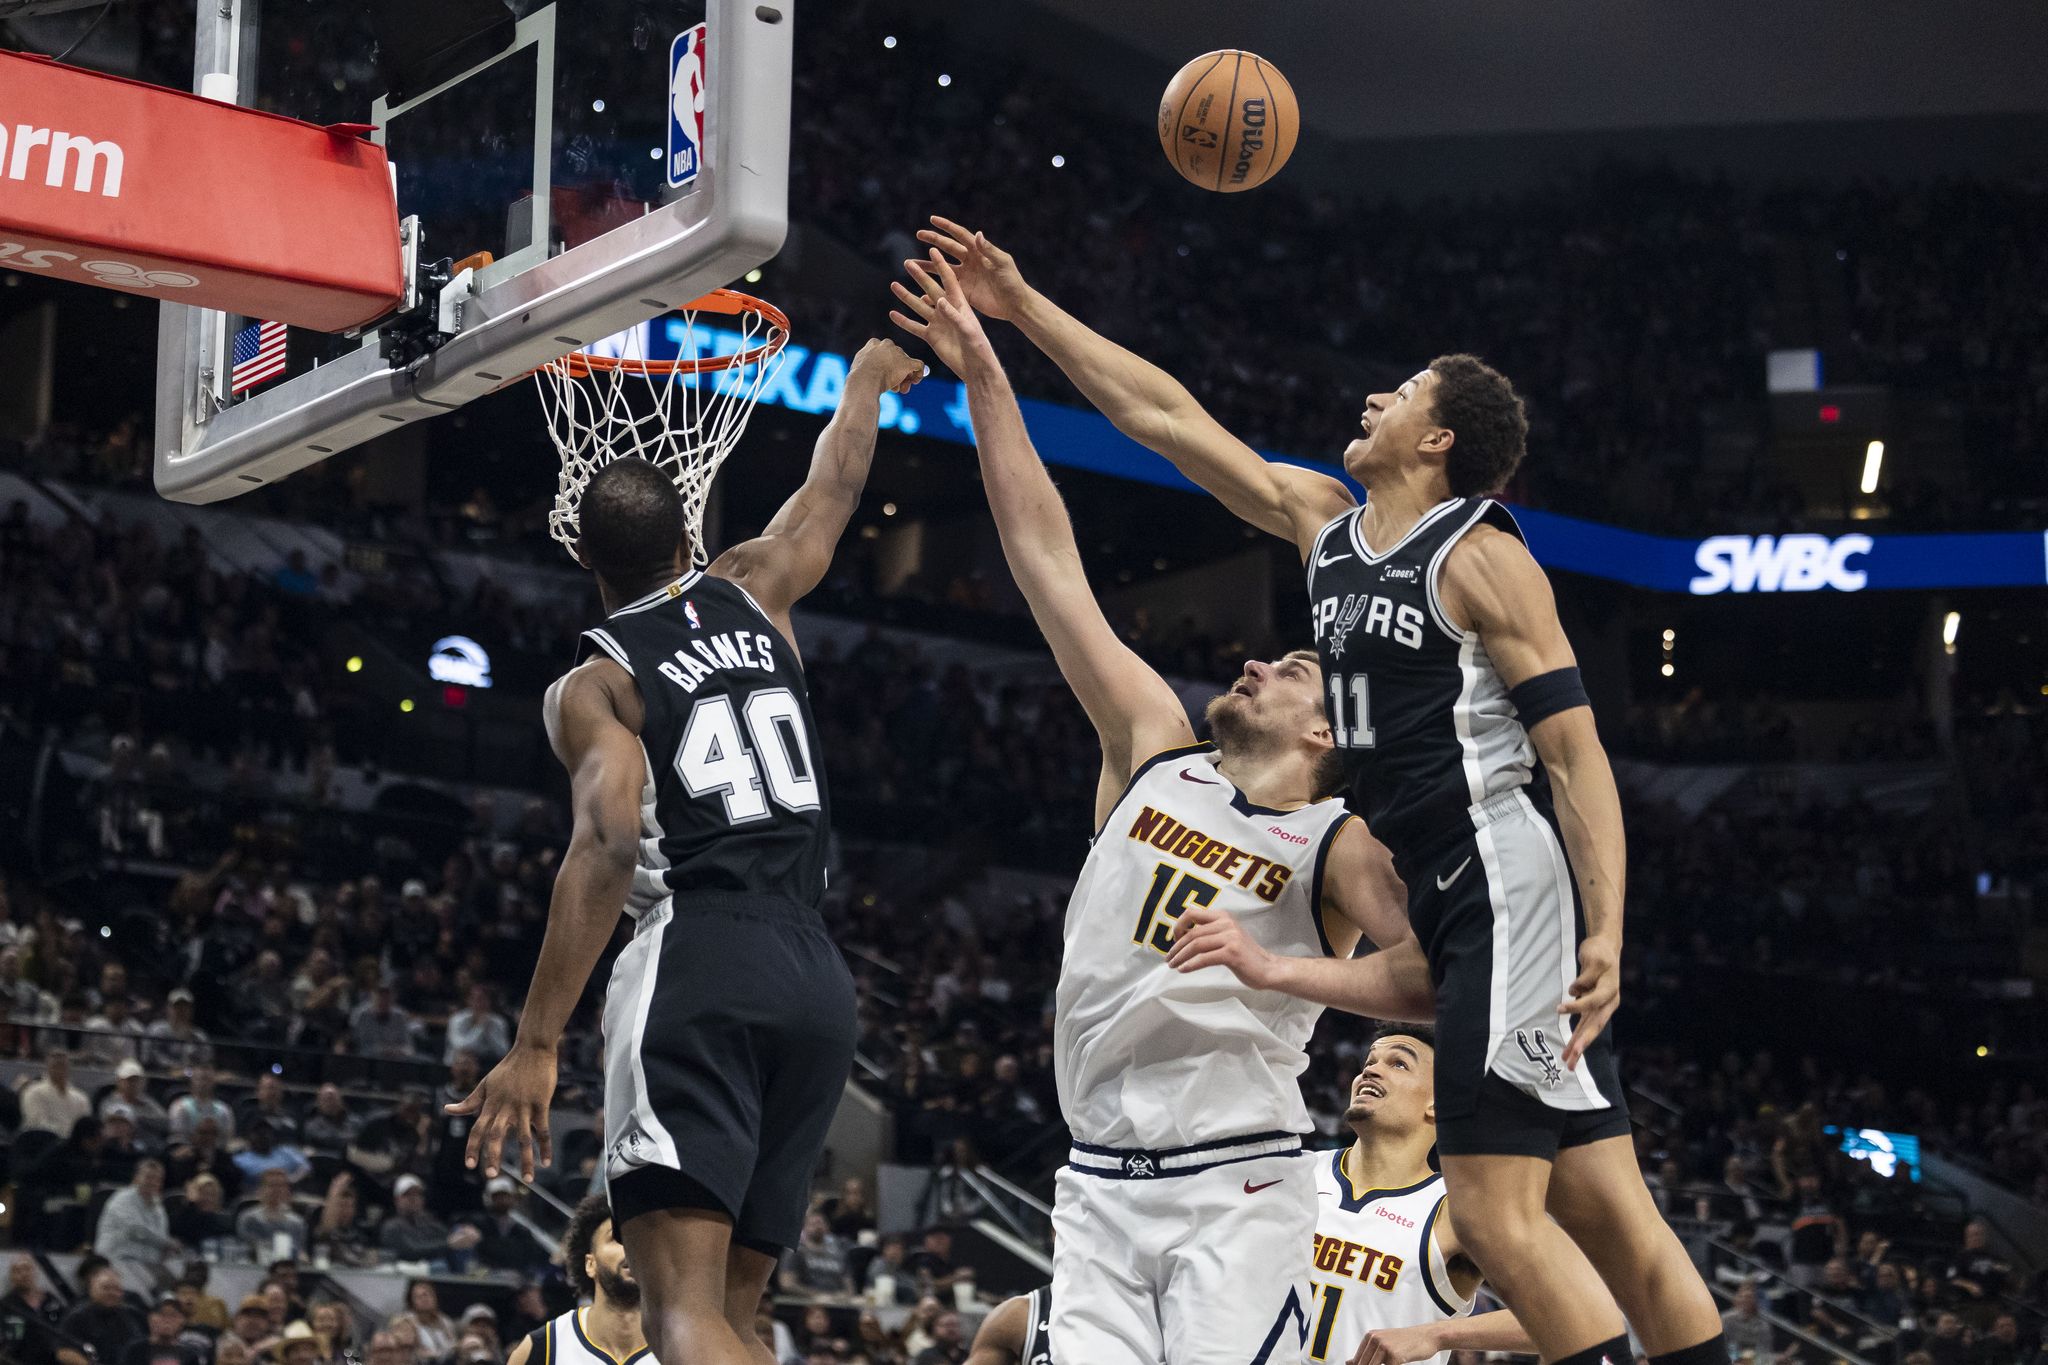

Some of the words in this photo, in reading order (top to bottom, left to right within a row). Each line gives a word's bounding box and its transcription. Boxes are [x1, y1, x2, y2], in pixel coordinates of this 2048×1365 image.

[0, 121, 125, 198] rm
[673, 147, 693, 177] NBA
[1229, 97, 1266, 184] Wilson
[1385, 568, 1416, 580] LEDGER
[1688, 533, 1875, 596] SWBC
[657, 630, 776, 694] BARNES
[1329, 673, 1376, 749] 11
[672, 686, 822, 826] 40
[1128, 805, 1295, 905] NUGGETS
[1266, 825, 1310, 846] ibotta
[1130, 861, 1223, 957] 15
[1374, 1206, 1416, 1229] ibotta
